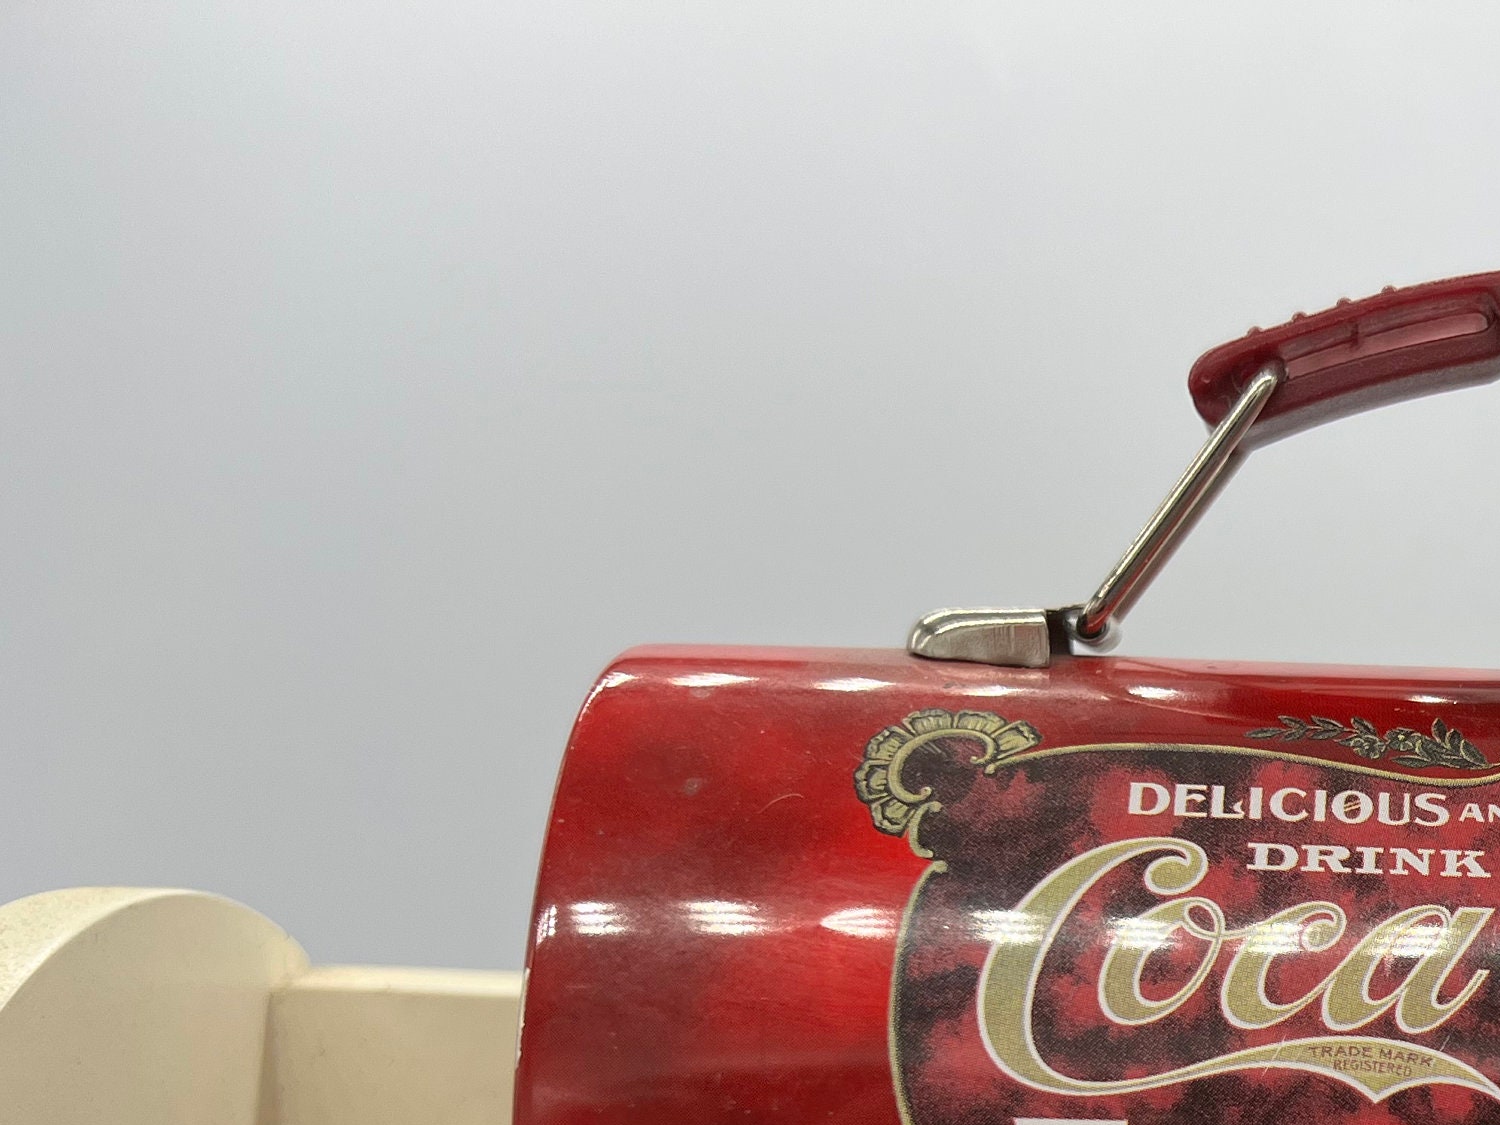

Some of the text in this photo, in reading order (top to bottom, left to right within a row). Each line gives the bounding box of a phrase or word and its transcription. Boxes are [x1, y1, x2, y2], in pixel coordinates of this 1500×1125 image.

[1127, 781, 1449, 827] DELICIOUS
[1246, 841, 1491, 879] DRINK
[1308, 1045, 1434, 1067] TRADE MARK
[1332, 1059, 1413, 1077] REGISTERED
